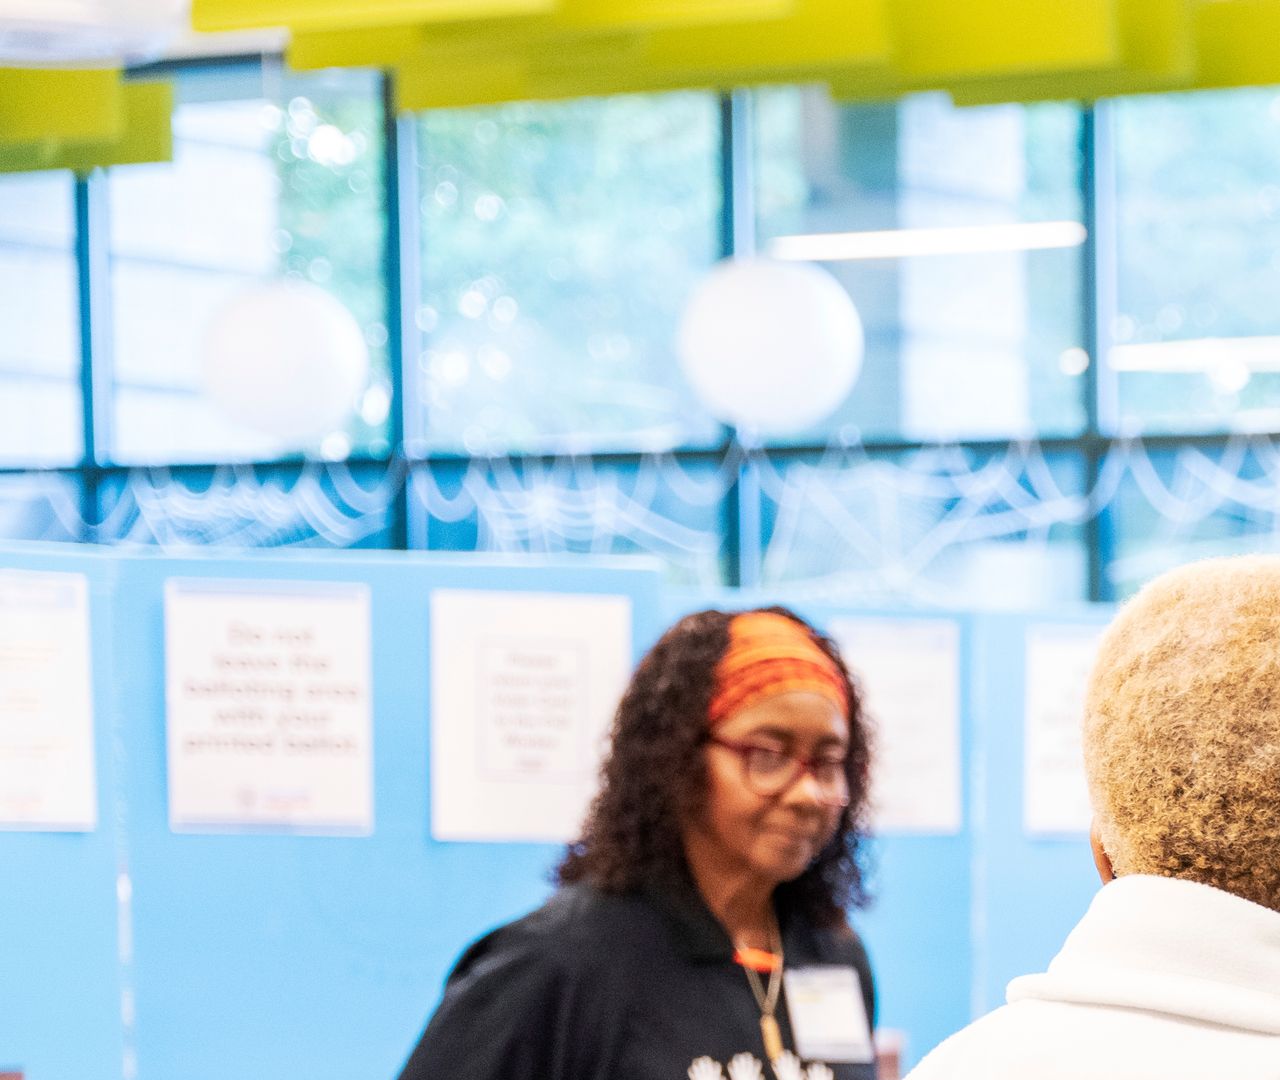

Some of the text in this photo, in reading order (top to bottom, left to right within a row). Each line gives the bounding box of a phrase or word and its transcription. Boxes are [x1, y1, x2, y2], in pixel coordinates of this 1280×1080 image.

[227, 619, 264, 646] Do
[212, 652, 280, 675] leave
[212, 706, 332, 736] with your
[182, 731, 276, 757] printed
